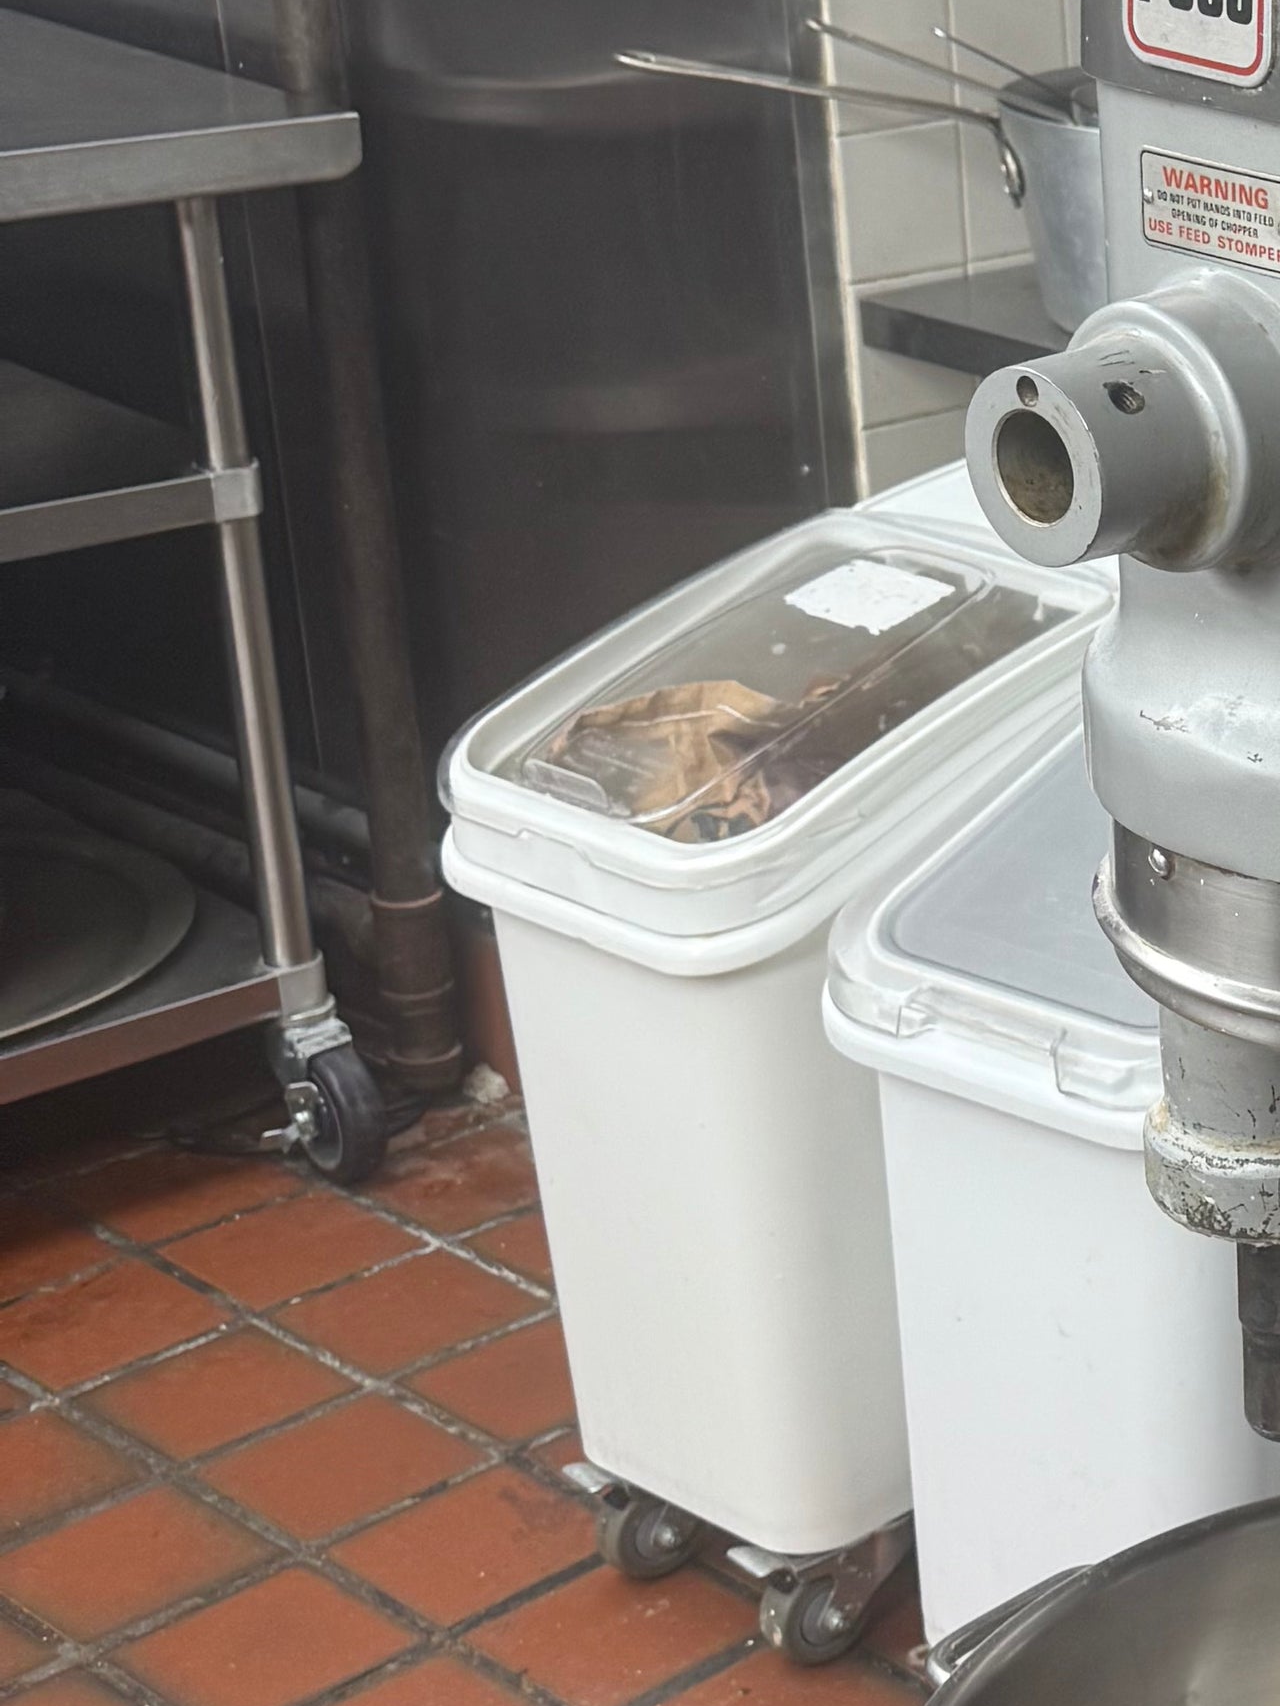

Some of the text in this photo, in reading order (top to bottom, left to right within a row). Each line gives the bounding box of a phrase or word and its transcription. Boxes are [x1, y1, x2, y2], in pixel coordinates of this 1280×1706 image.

[1162, 165, 1270, 211] WARNING
[1157, 189, 1275, 227] DO NOT PUT HANDS INTO FEED
[1171, 208, 1259, 239] OPENING OF CHOPPER
[1149, 217, 1173, 235] USE
[1178, 225, 1211, 245] FEED
